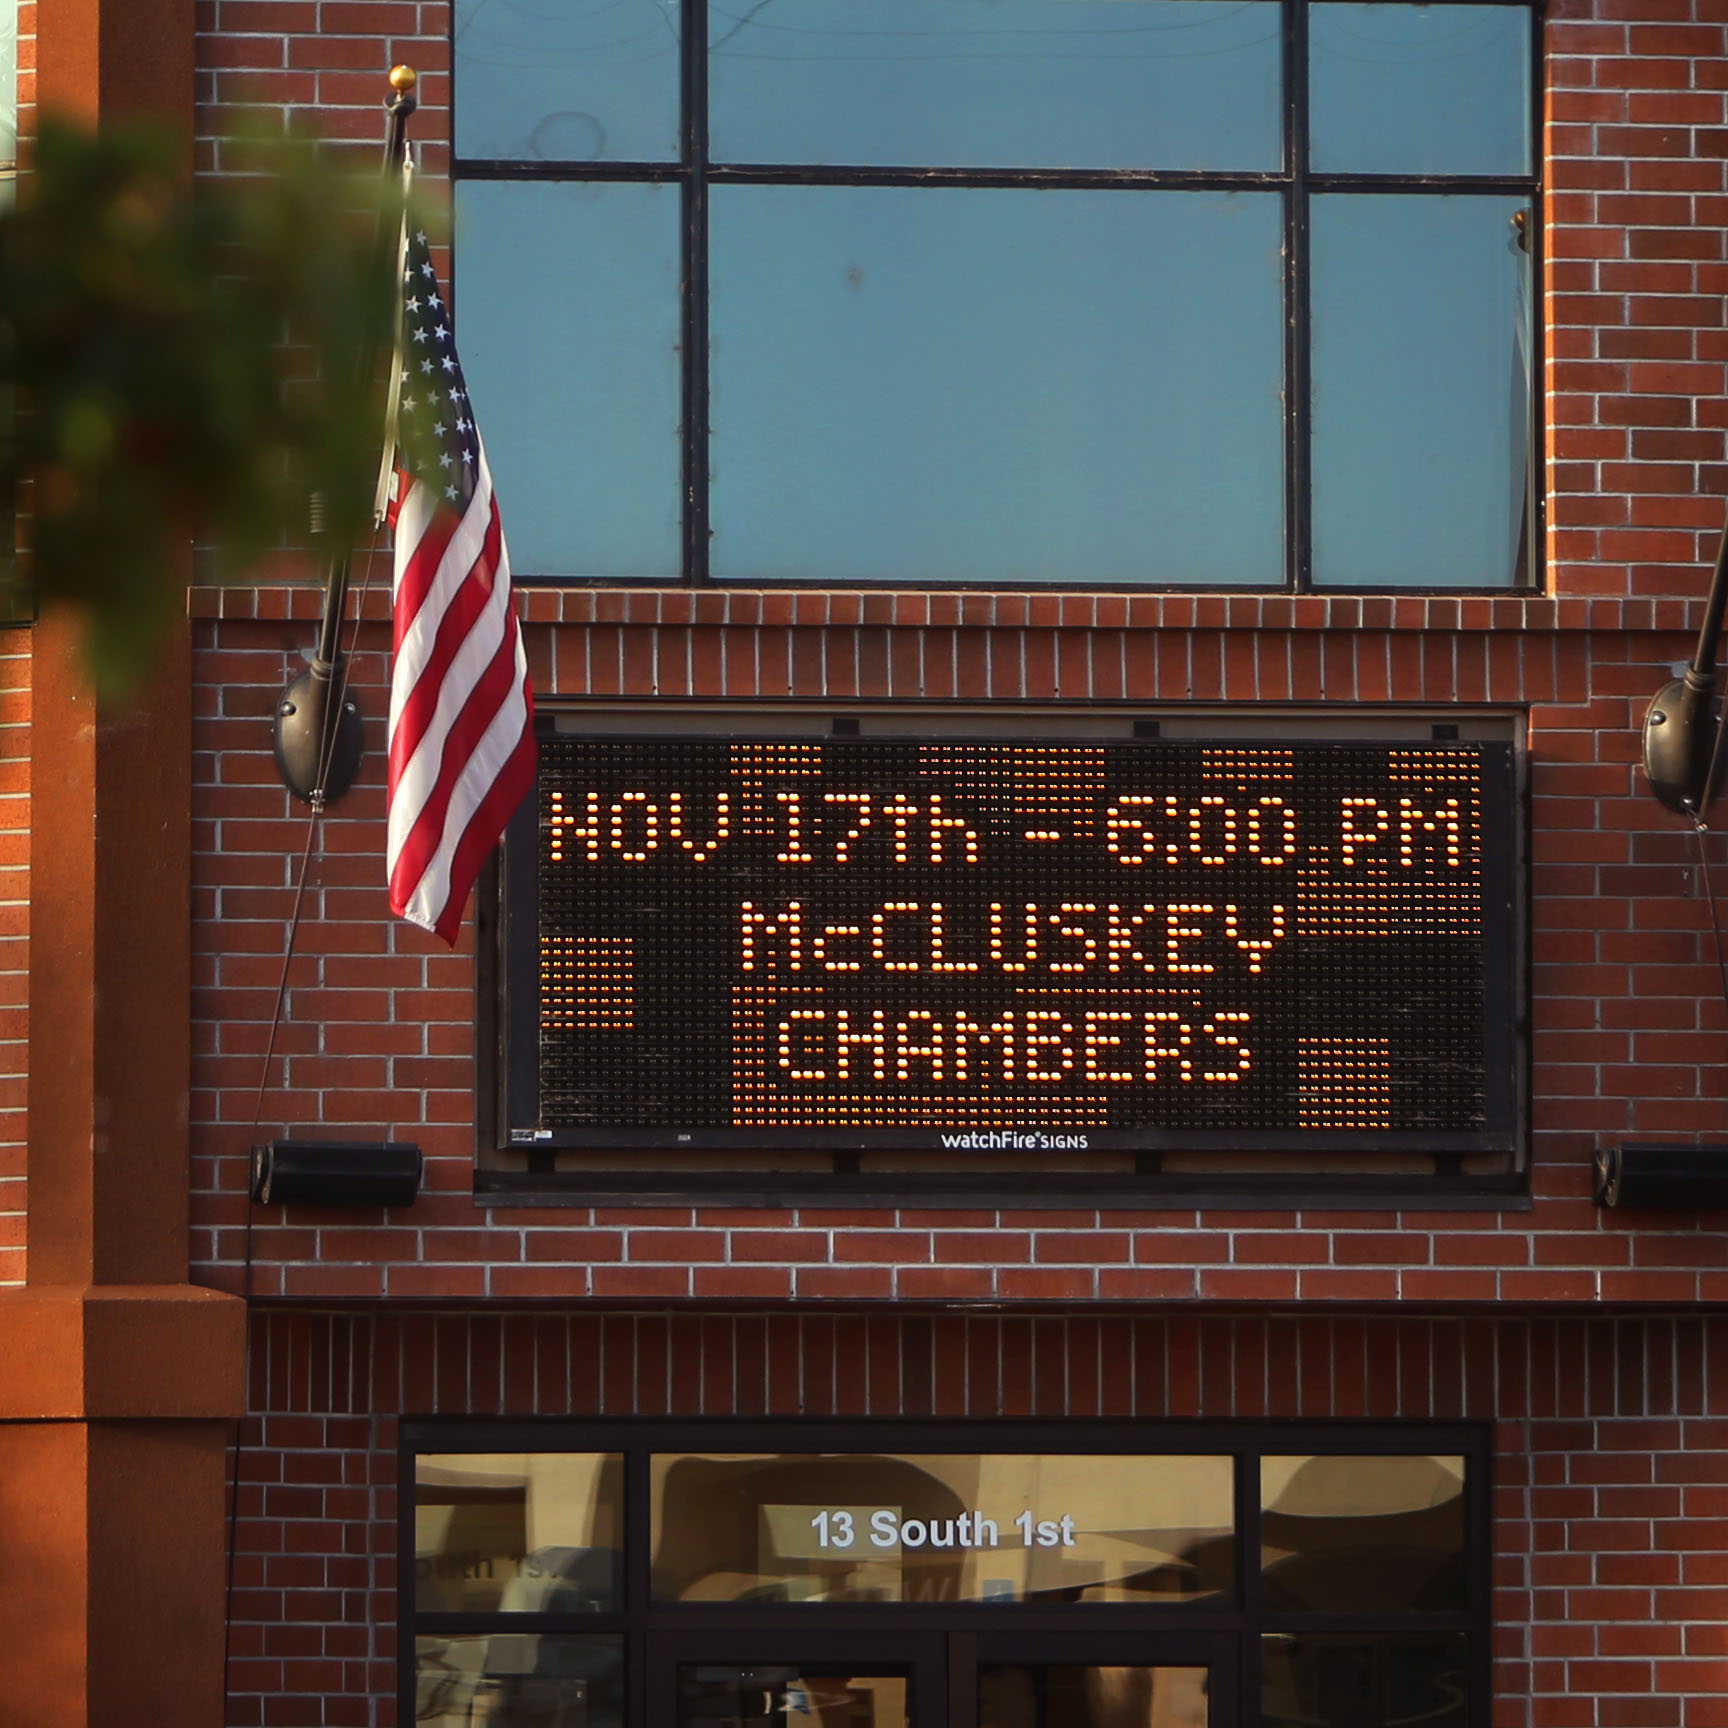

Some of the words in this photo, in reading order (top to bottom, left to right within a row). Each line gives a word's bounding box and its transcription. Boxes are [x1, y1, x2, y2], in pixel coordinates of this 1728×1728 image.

[551, 791, 729, 862] NOV
[776, 792, 978, 863] 17th
[1106, 795, 1296, 865] 6:00
[1341, 797, 1460, 867] PM
[741, 900, 1285, 972] McCLUSKEY
[778, 1009, 1251, 1080] CHAMBERS
[1040, 1134, 1089, 1149] SIGNS
[811, 1510, 855, 1548] 13
[870, 1509, 999, 1548] South
[1015, 1509, 1076, 1548] 1st
